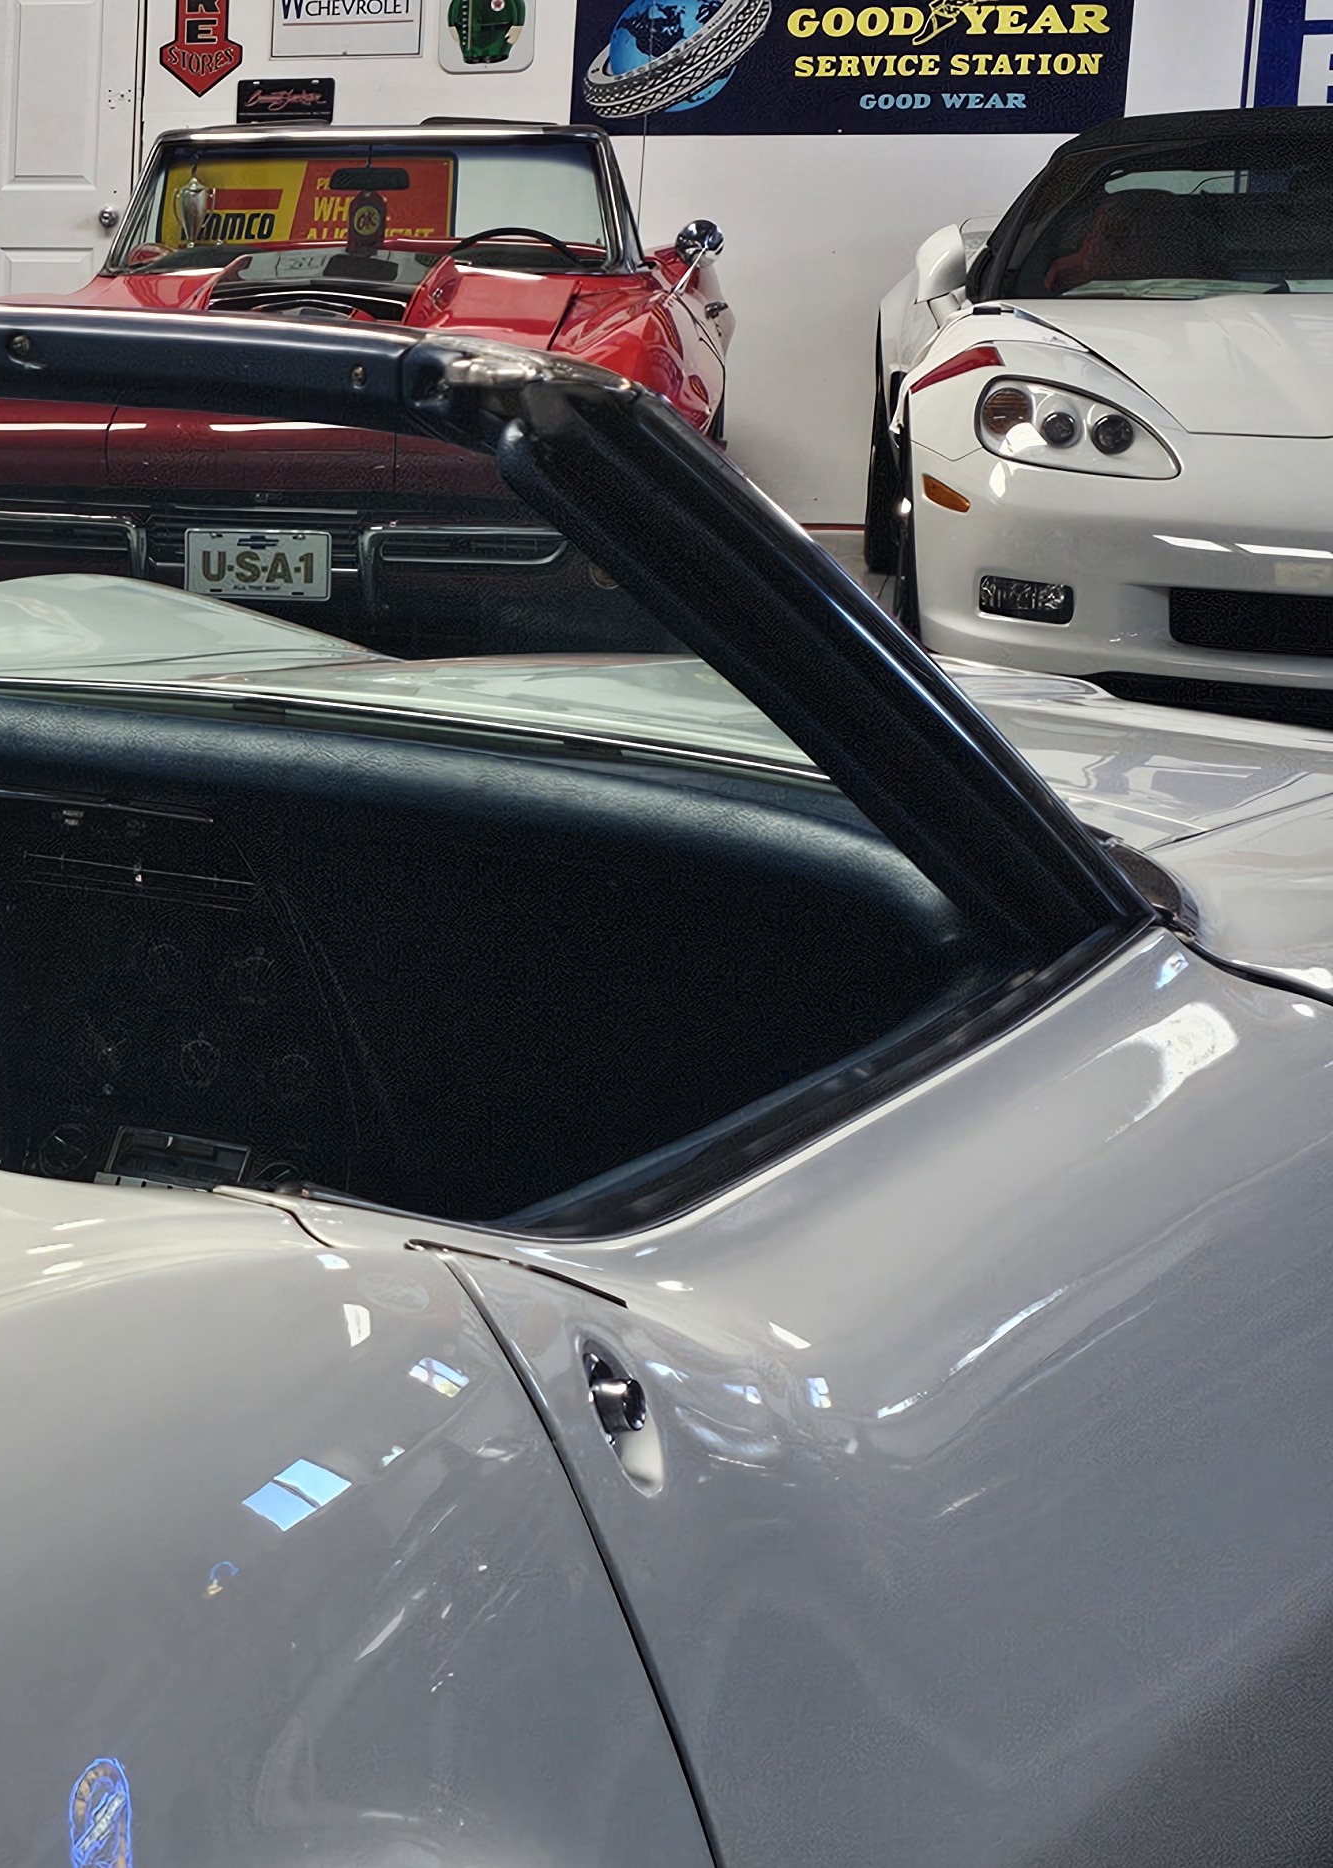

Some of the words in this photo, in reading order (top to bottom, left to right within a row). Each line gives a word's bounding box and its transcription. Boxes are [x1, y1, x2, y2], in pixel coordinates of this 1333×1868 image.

[305, 0, 410, 16] CHEVROLET
[167, 47, 234, 76] STORES
[794, 55, 940, 77] SERVICE
[950, 54, 1103, 76] STATION
[859, 93, 931, 109] GOOD
[941, 93, 1026, 109] WEAR
